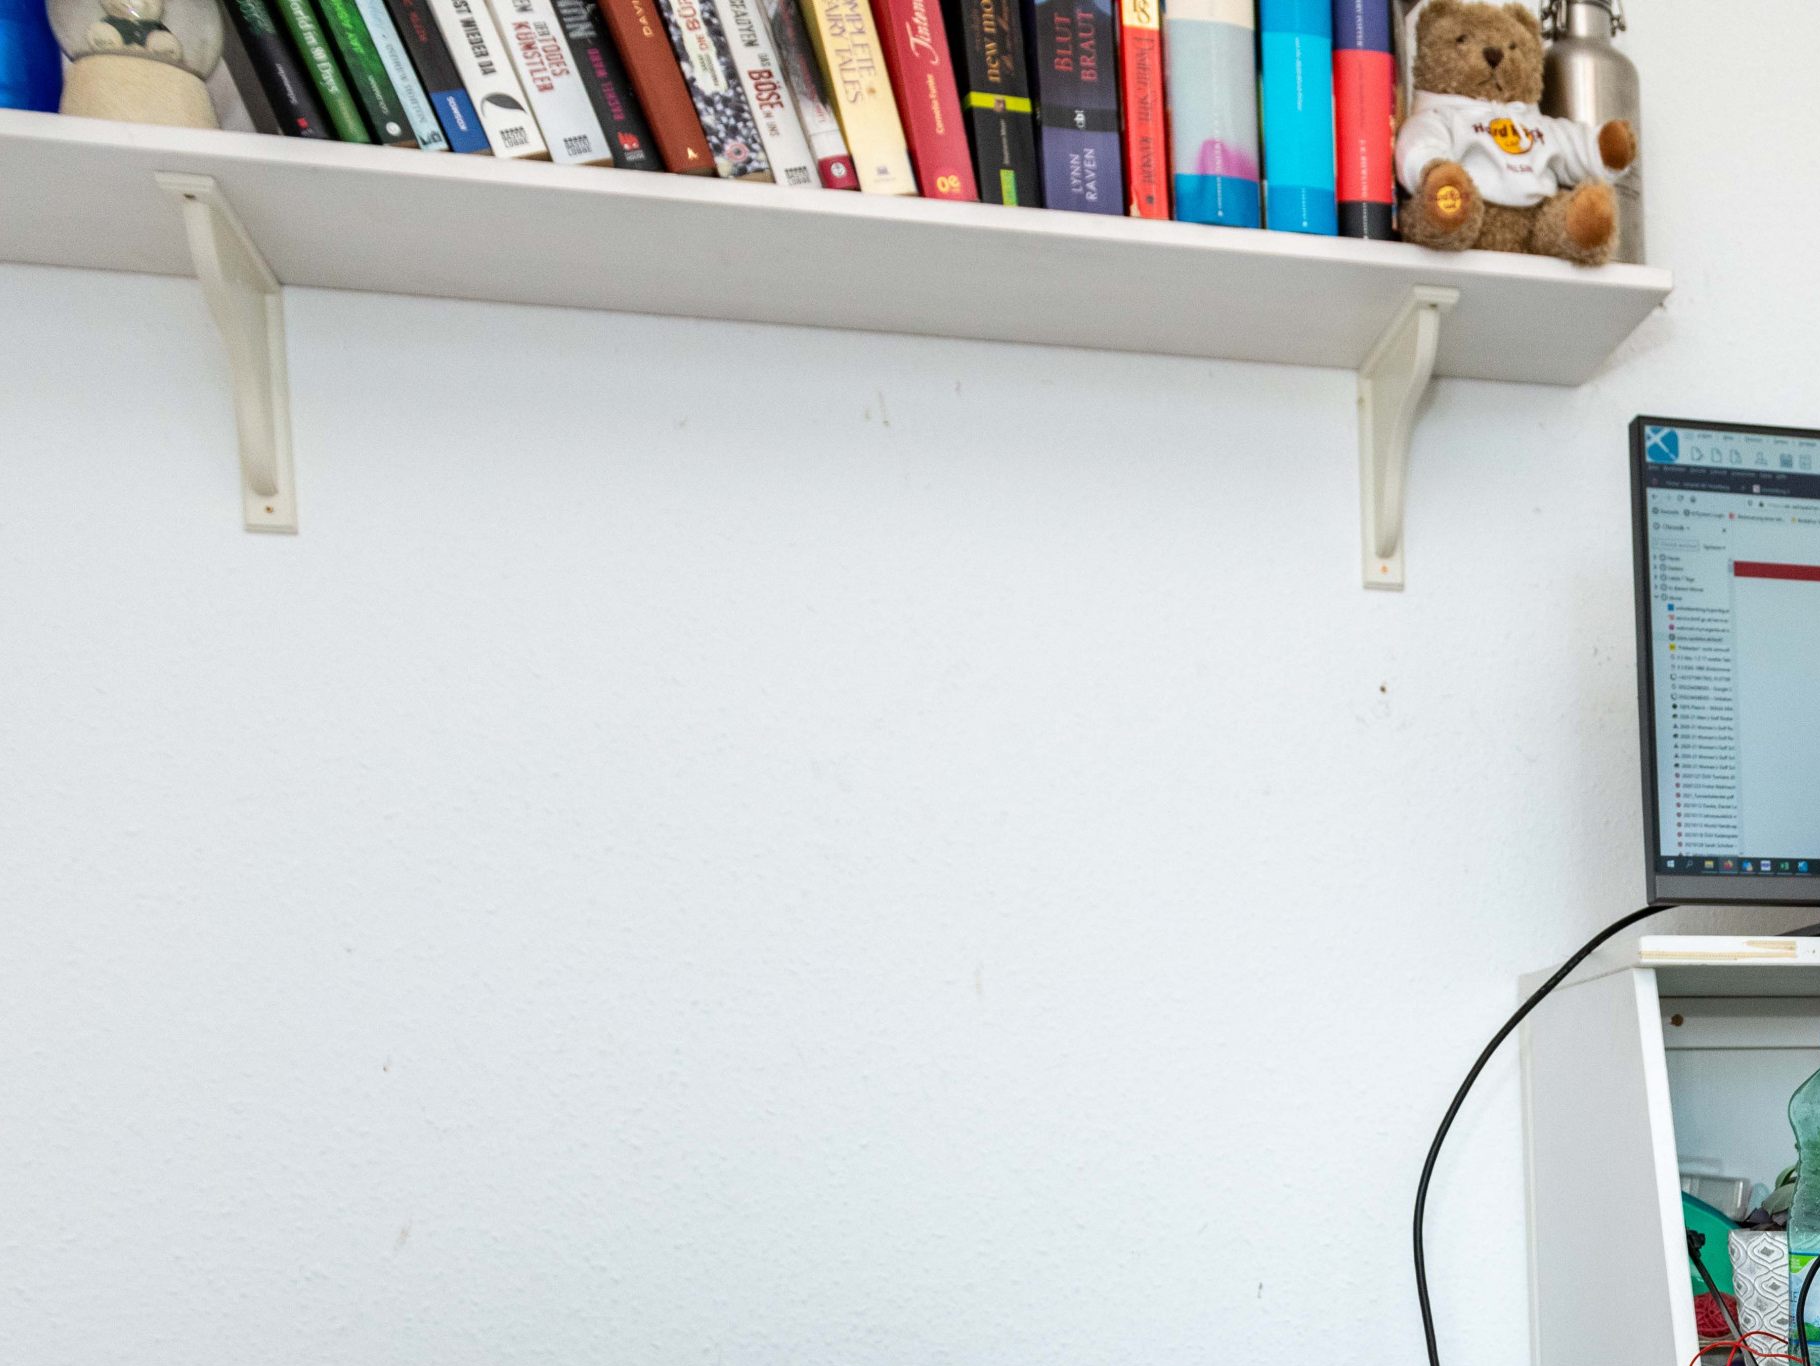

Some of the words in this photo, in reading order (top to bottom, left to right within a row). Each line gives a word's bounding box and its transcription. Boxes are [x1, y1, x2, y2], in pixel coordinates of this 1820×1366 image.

[453, 0, 472, 15] ST
[631, 0, 654, 38] DAVI
[826, 0, 846, 39] AIRY
[290, 0, 316, 34] orld
[316, 61, 339, 95] Days
[460, 18, 489, 58] WIEDER
[512, 20, 555, 94] KÜNSTLER
[542, 36, 570, 79] TODES
[846, 0, 876, 79] MPLETE
[1053, 12, 1074, 73] BLUT
[1075, 9, 1098, 82] BRAUT
[478, 58, 497, 76] DA
[757, 53, 771, 68] DAS
[834, 48, 864, 105] TALES
[984, 48, 1001, 83] new
[747, 68, 785, 111] BÖSE
[447, 95, 468, 132] KOSMOS
[765, 121, 780, 137] UNS
[1069, 153, 1084, 194] LYNN
[1083, 147, 1098, 202] RAVEN
